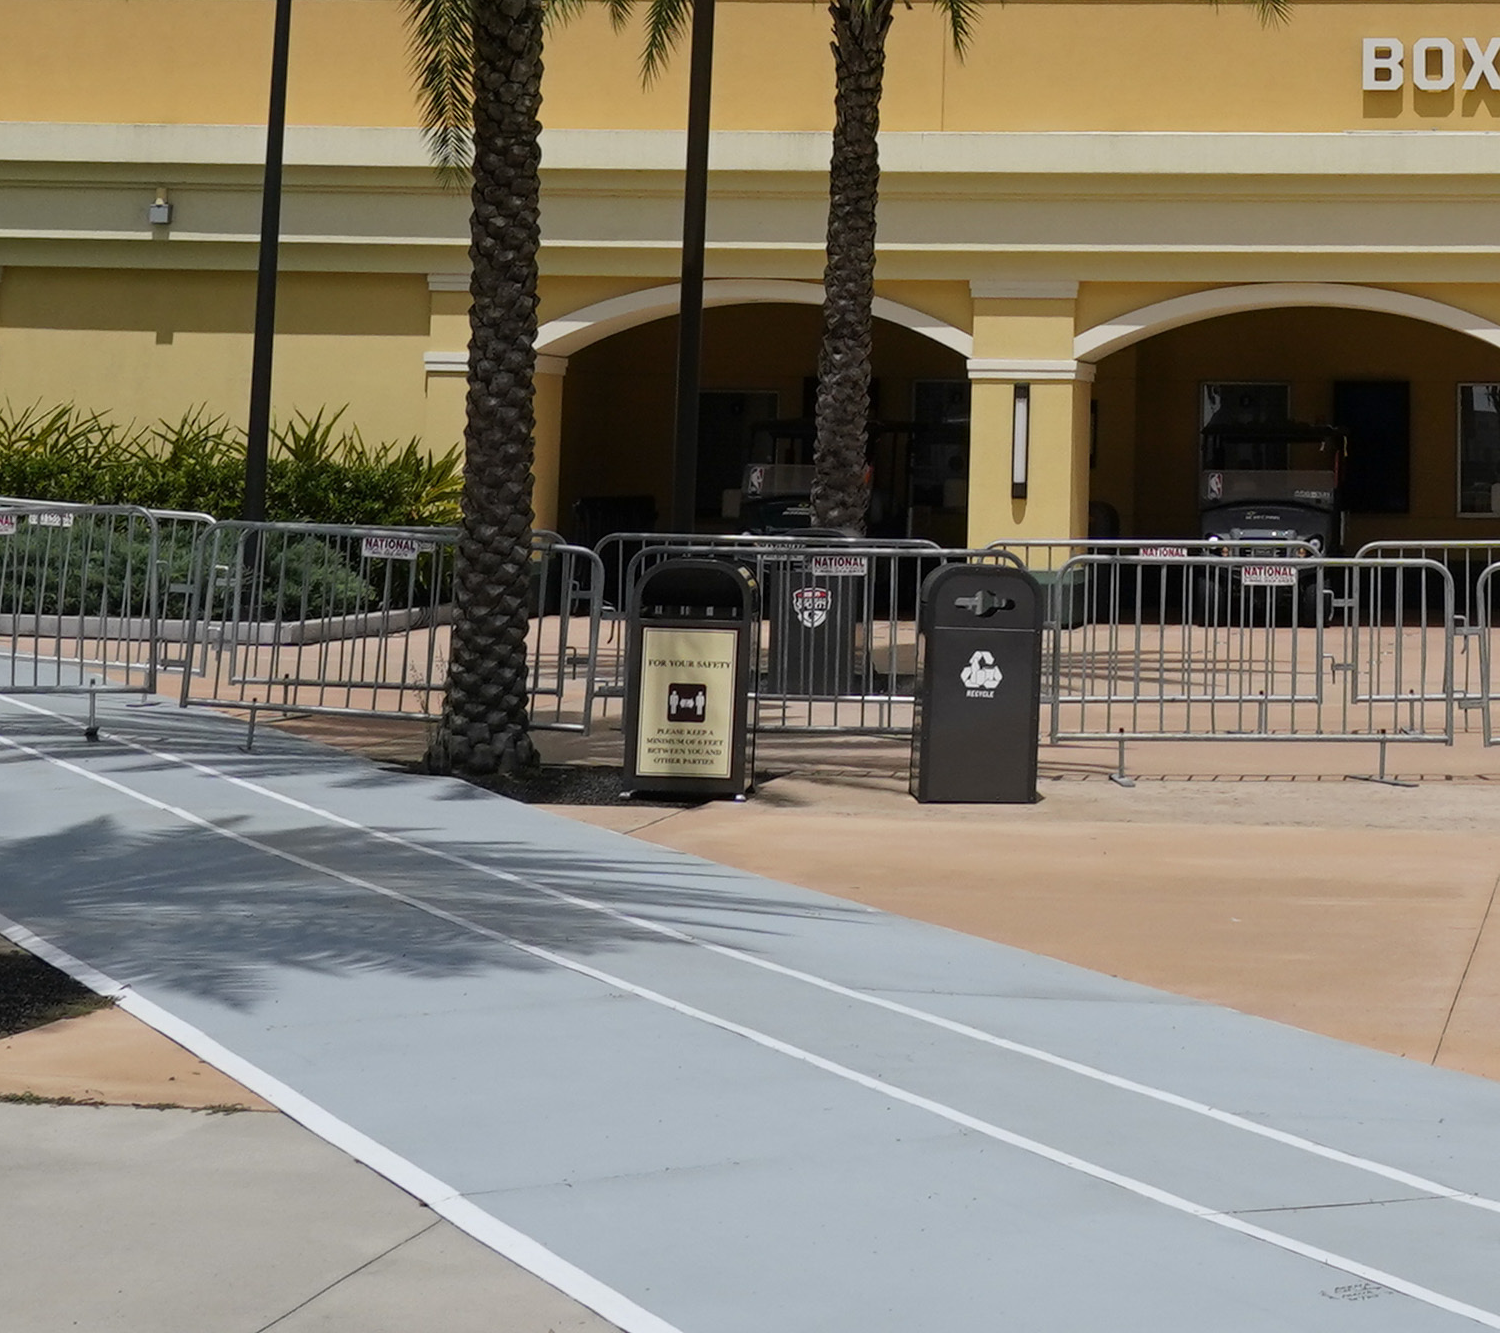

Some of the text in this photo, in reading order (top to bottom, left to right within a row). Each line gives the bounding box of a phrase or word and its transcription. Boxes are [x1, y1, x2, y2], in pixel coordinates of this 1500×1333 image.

[365, 538, 416, 550] NATIONAL
[1142, 548, 1185, 557] NATIONAL
[814, 557, 864, 567] NATIONAL
[1243, 566, 1294, 577] NATIONAL
[649, 659, 731, 669] FOR YOUR SAFETY
[966, 690, 994, 698] RECYCLE
